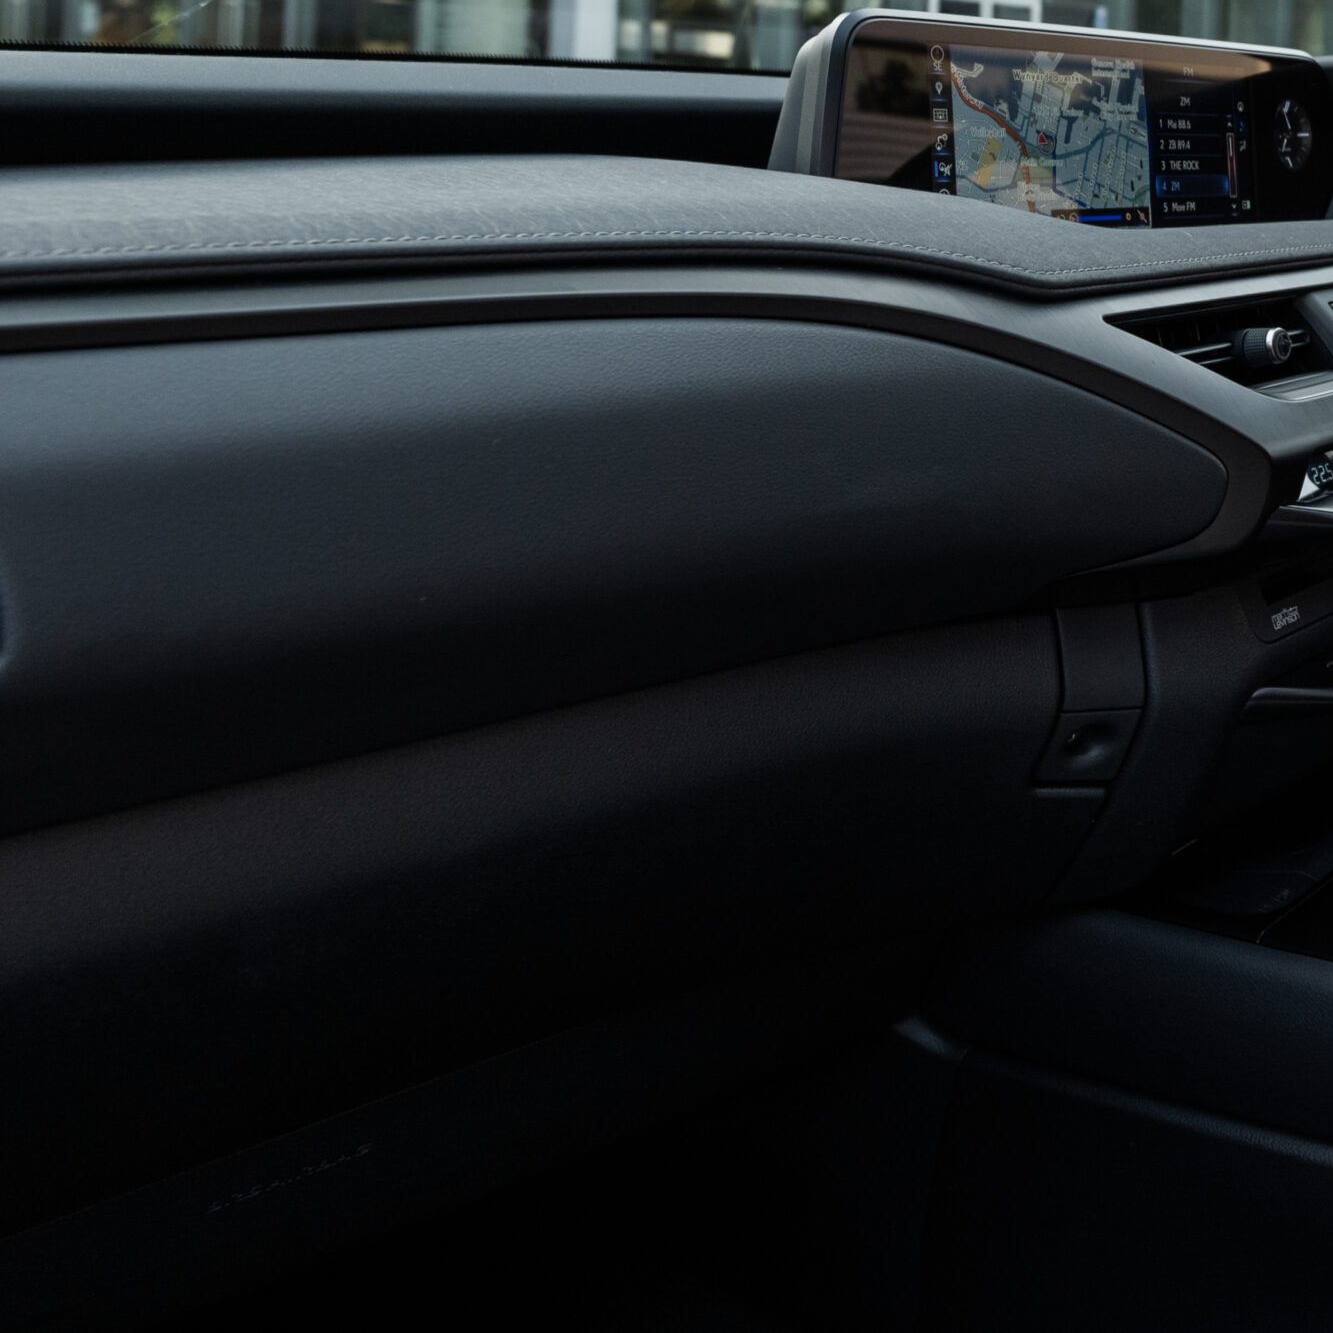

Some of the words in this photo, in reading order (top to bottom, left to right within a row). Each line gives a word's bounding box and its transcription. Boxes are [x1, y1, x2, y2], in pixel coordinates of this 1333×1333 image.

[1012, 69, 1049, 83] Wynyard
[1183, 67, 1194, 77] FM
[1180, 96, 1190, 106] ZM
[1169, 160, 1182, 171] THE
[1182, 160, 1200, 171] ROCK
[1163, 202, 1169, 213] 5
[1186, 201, 1196, 212] FM
